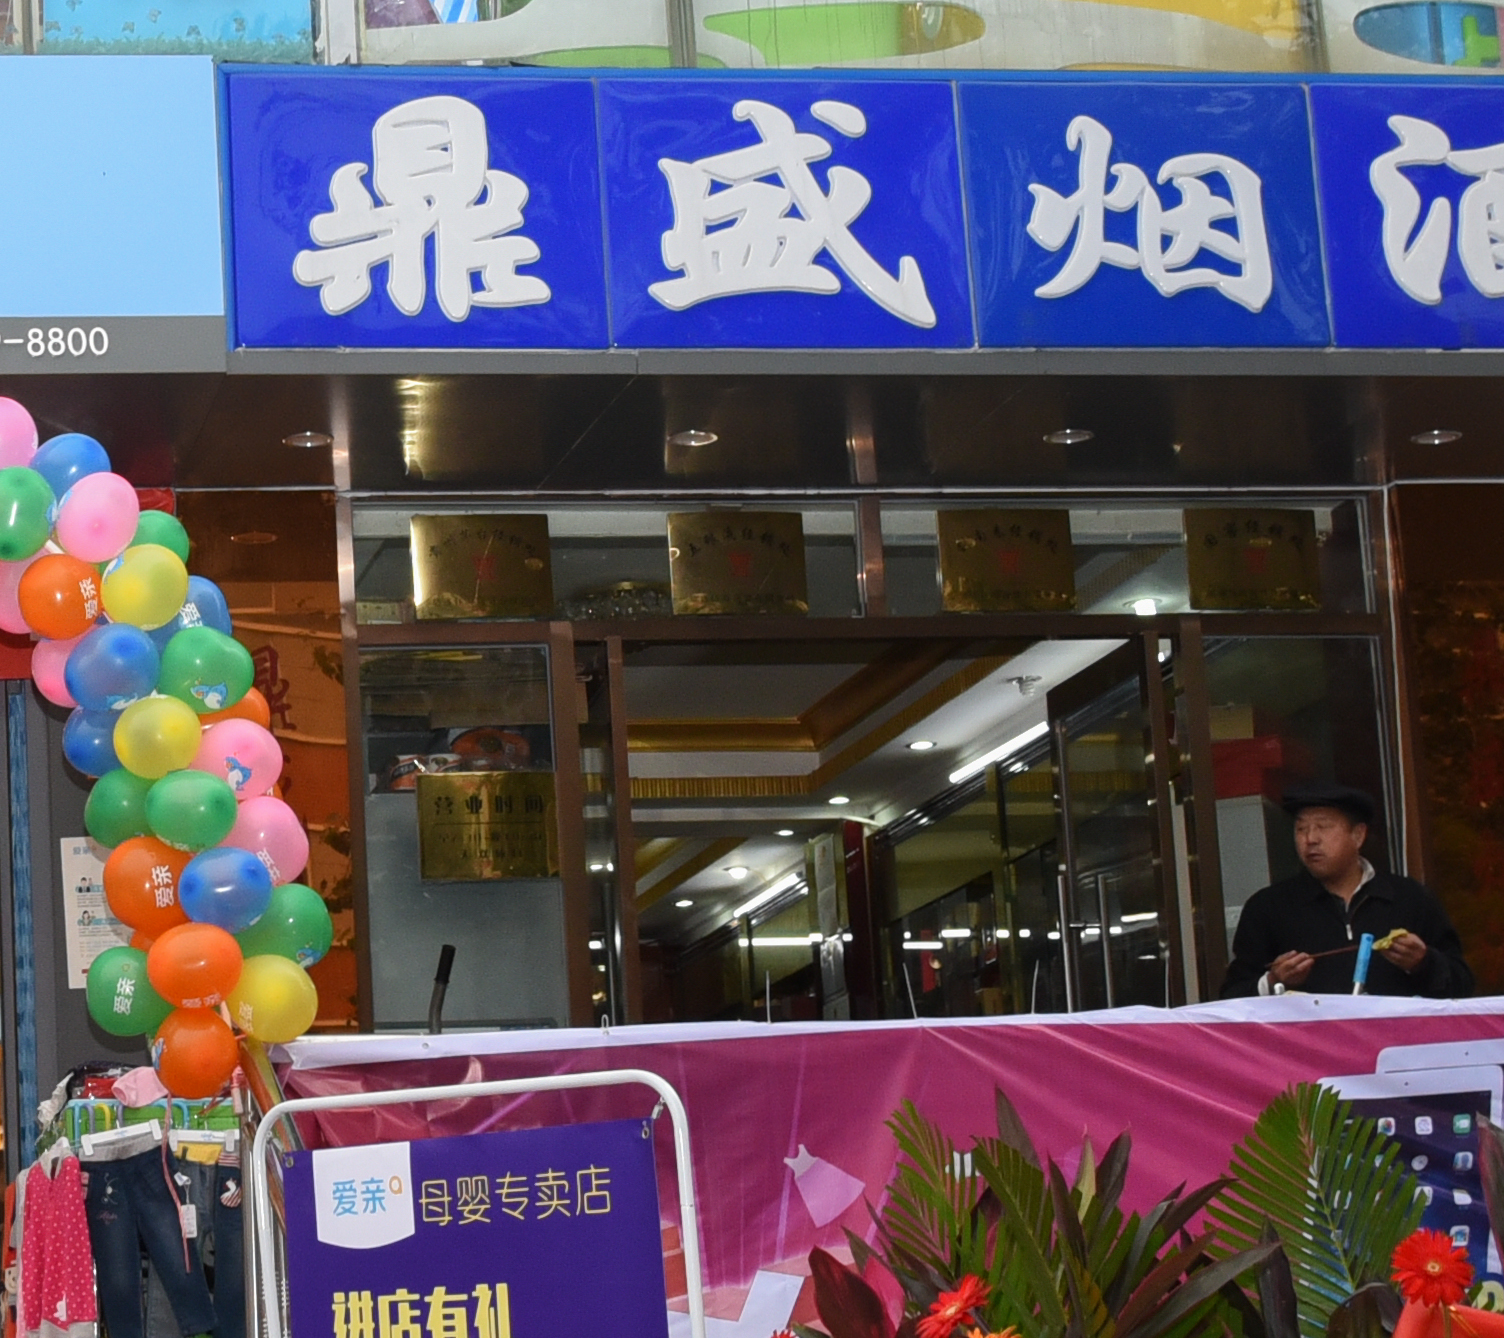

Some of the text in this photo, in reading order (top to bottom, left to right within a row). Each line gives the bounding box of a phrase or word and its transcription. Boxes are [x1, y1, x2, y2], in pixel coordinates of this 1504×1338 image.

[332, 1164, 612, 1227] 爱亲 母婴专卖店
